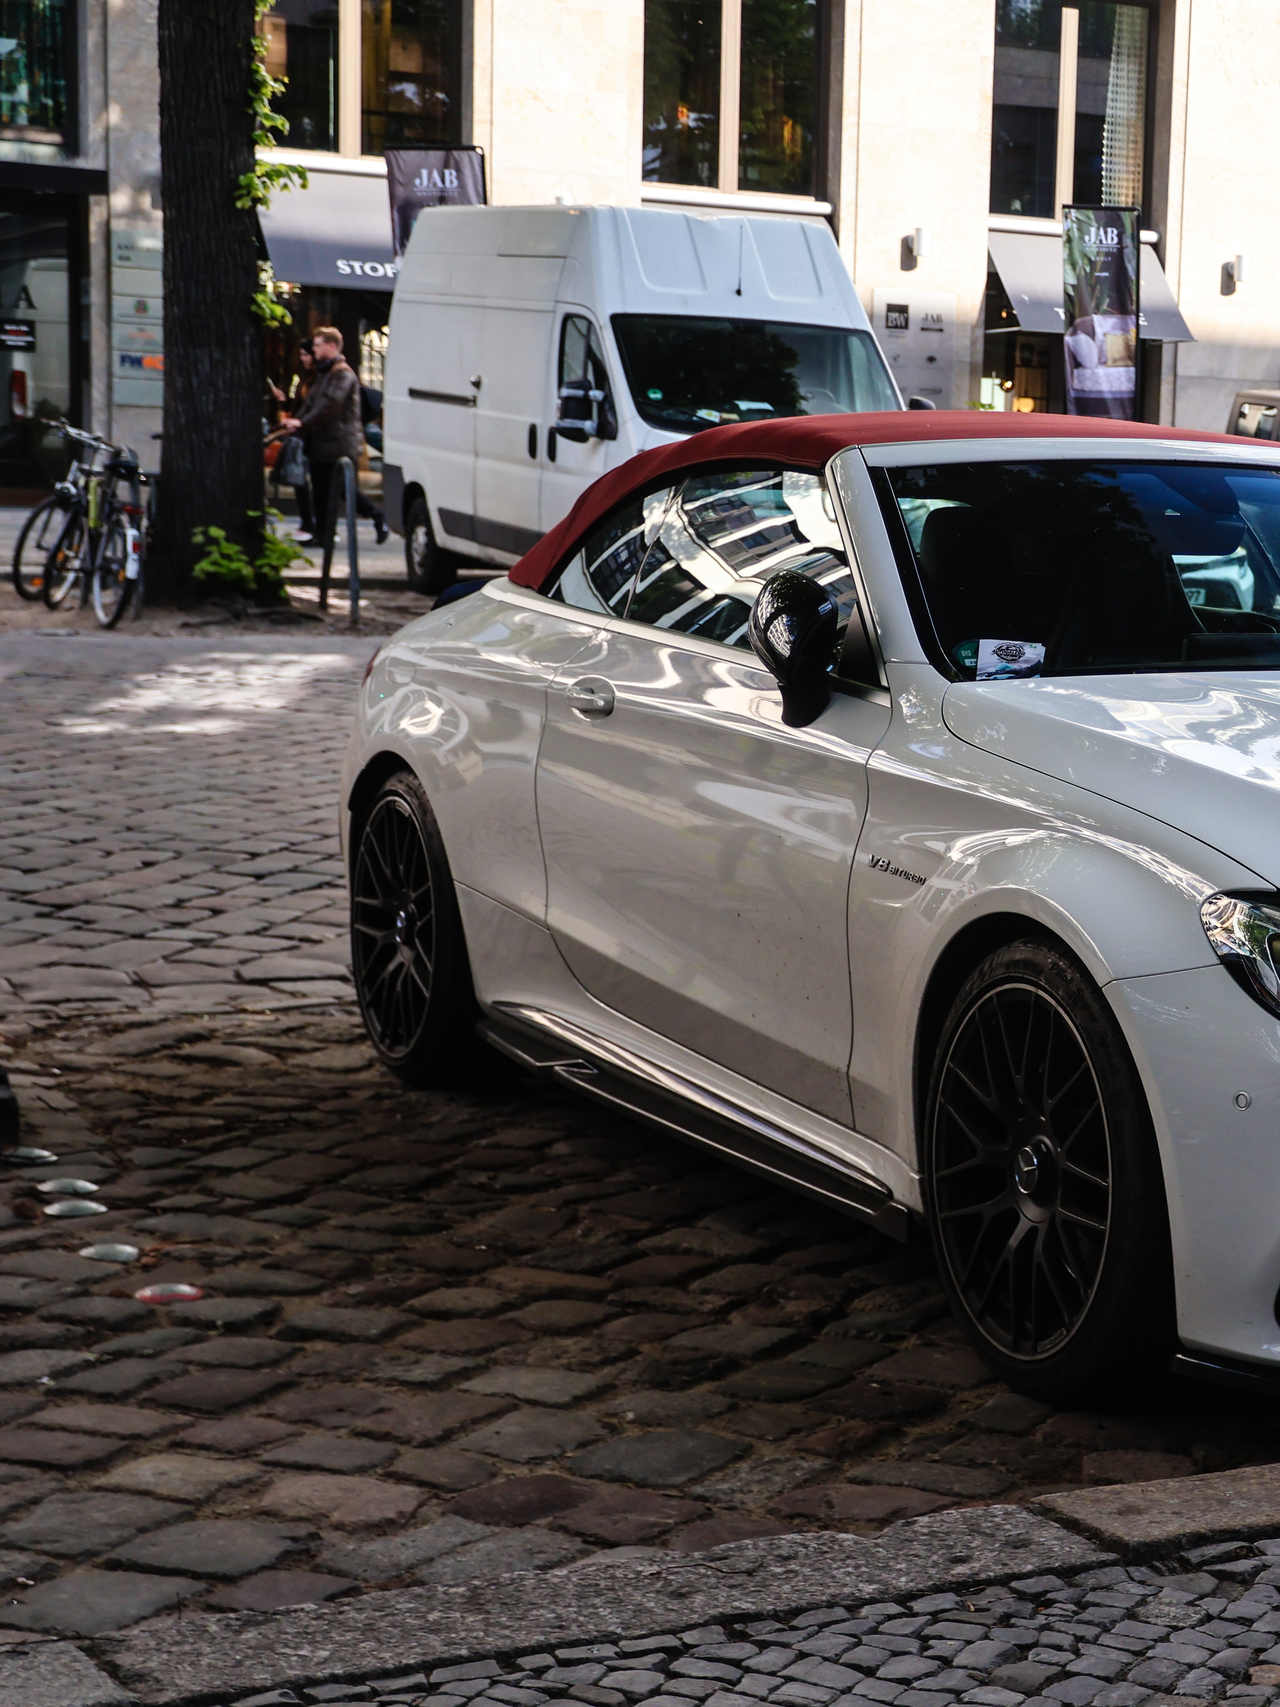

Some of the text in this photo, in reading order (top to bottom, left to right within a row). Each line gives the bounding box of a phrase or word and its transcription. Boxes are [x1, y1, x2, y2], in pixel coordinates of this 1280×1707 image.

[414, 168, 459, 189] JAB
[1083, 226, 1119, 245] JAB
[868, 854, 927, 886] V8 BITURBO
